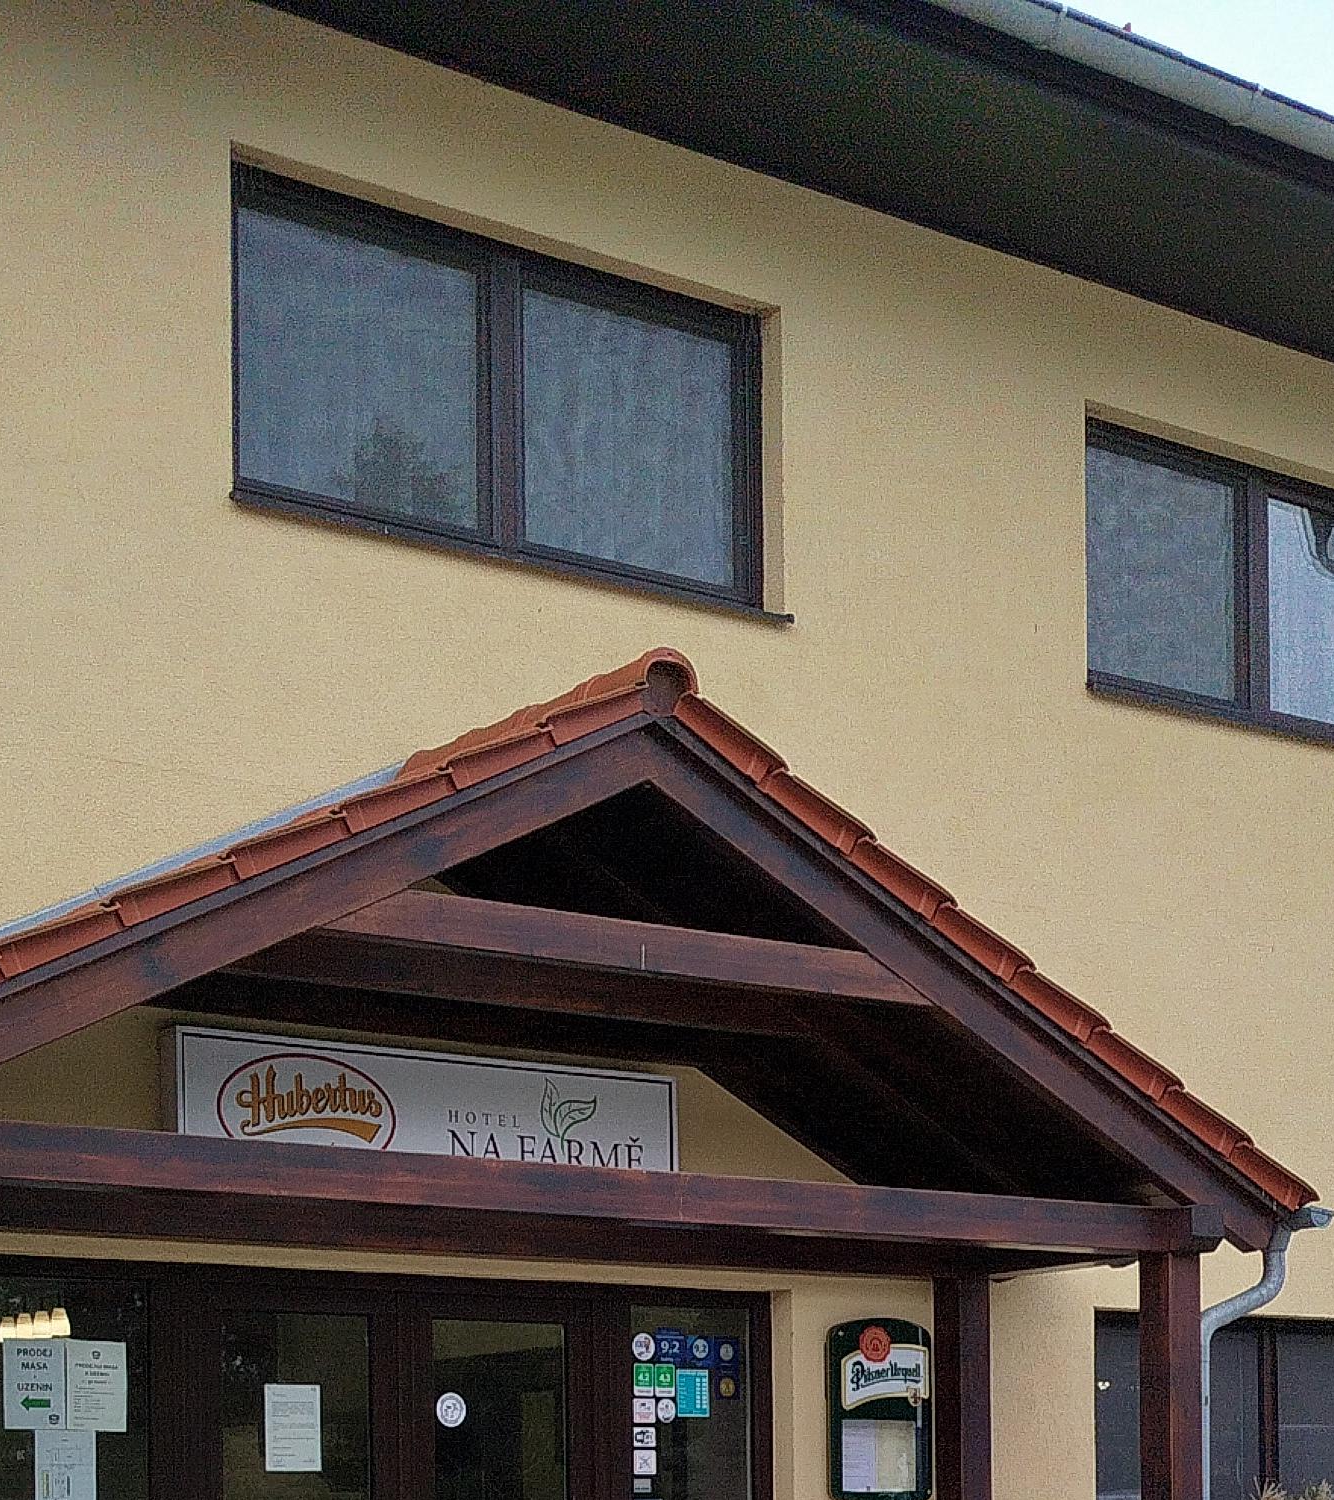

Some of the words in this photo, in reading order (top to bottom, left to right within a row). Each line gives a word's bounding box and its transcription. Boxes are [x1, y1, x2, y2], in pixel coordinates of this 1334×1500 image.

[235, 1064, 383, 1128] Hubertus
[448, 1109, 521, 1128] HOTEL
[447, 1129, 500, 1159] NA
[517, 1135, 644, 1169] FARMĚ
[16, 1347, 53, 1357] PRODEJ
[20, 1361, 48, 1371] MASA
[850, 1361, 890, 1391] Pilsner
[889, 1360, 921, 1384] Urquell
[16, 1382, 53, 1392] UZENIN
